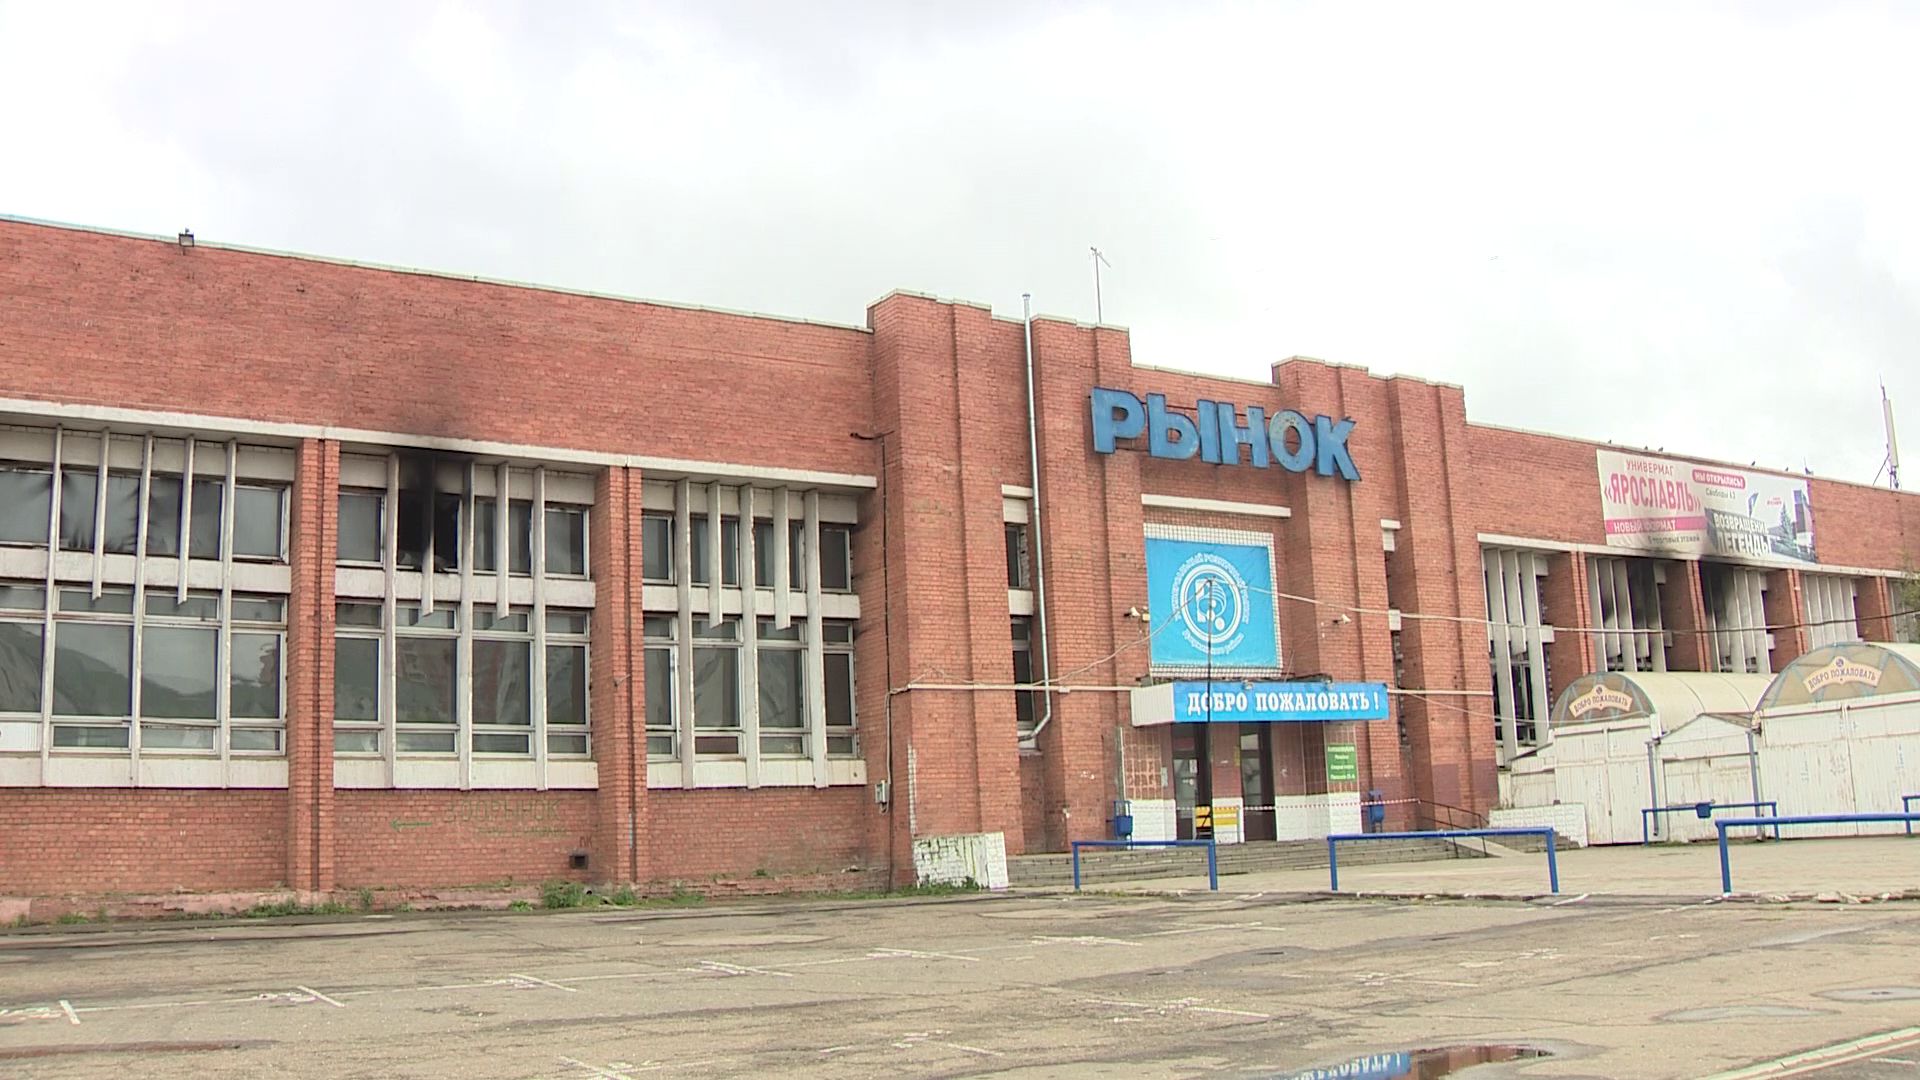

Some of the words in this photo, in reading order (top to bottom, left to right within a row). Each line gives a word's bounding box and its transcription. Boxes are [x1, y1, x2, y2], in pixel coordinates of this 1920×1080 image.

[1091, 386, 1361, 481] РЫНОК
[1626, 459, 1673, 476] УНИВЕРМАГ
[1604, 473, 1701, 512] «ЯРОСЛАВЛЬ»
[1614, 520, 1643, 533] НОВЫЙ
[1718, 532, 1772, 557] ЛЕГЕНДЫ
[1808, 672, 1829, 689] ДОБРО
[1831, 668, 1876, 681] ПОЖАЛОВАТЬ
[1187, 692, 1247, 717] ДОБРО
